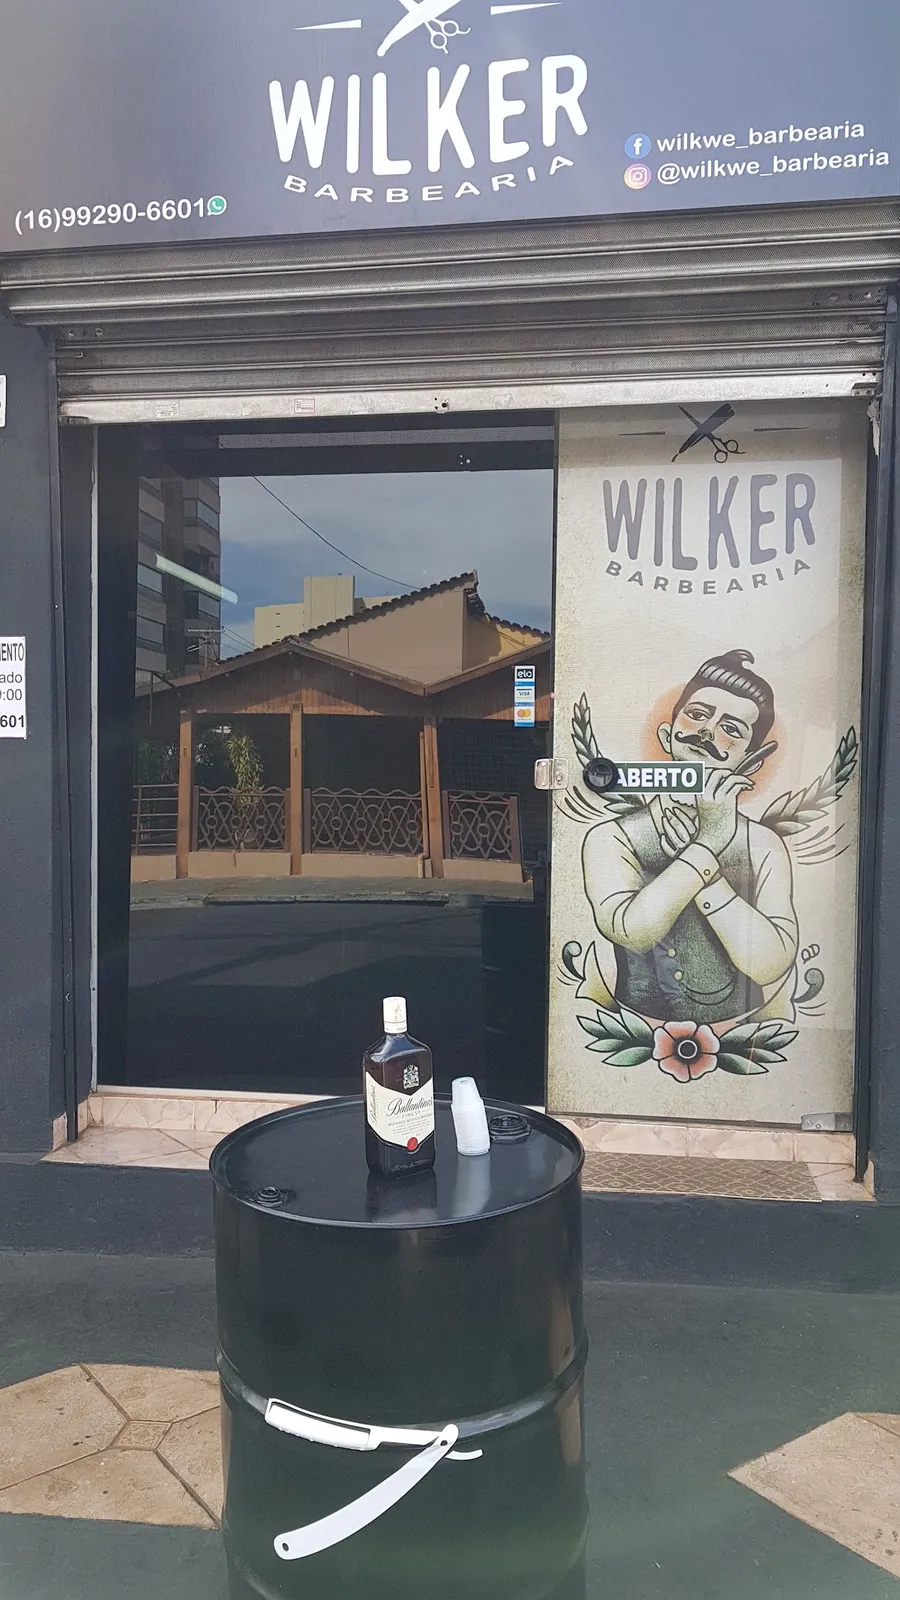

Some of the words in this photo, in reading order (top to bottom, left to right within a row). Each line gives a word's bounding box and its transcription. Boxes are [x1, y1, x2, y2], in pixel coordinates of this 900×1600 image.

[268, 54, 588, 176] WILKER
[656, 120, 865, 153] wilkwe_barbearia
[283, 155, 574, 203] BARBEARIA
[657, 148, 890, 185] @wilkwe_barbearia
[15, 197, 204, 235] (16)99290-6601
[603, 473, 816, 571] WILKER
[605, 558, 811, 595] BARBEARIA
[617, 767, 698, 788] ABERTO
